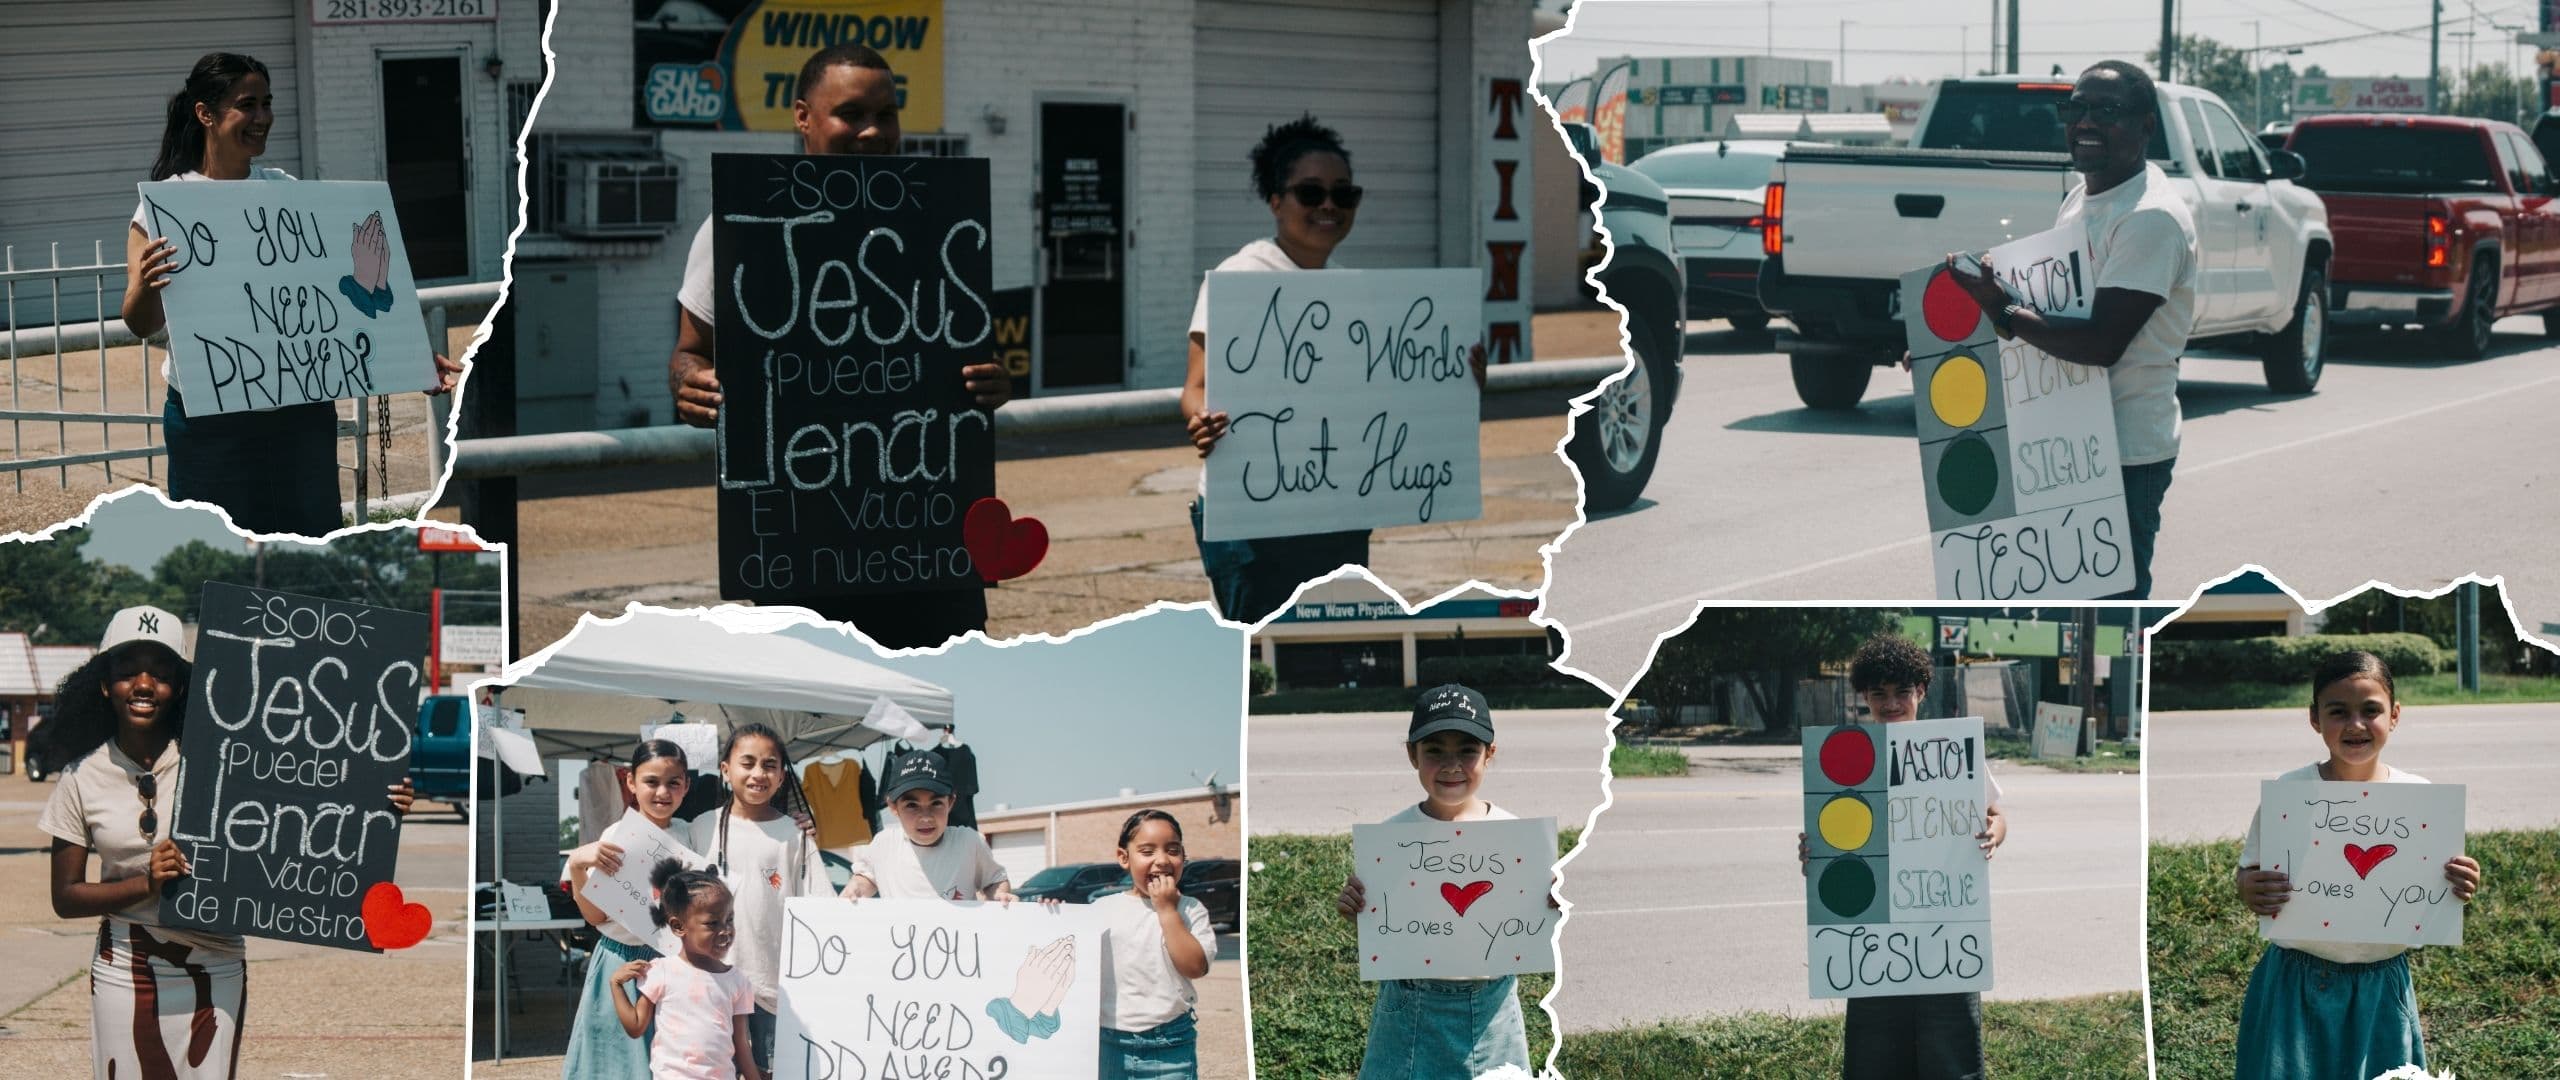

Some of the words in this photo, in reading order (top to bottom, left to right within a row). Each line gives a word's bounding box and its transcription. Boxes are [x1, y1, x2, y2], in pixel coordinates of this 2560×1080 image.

[763, 11, 929, 50] WINDOW
[2372, 81, 2409, 94] OPEN
[2377, 94, 2424, 107] HOURS
[1486, 78, 1526, 363] TINT
[244, 282, 338, 338] NEED
[1226, 287, 1330, 383] No
[1349, 297, 1465, 382] Words
[194, 332, 373, 413] PRAYER?
[1231, 407, 1338, 501] Just
[1358, 411, 1453, 522] Hugs
[2017, 435, 2107, 496] SIGUE
[748, 490, 797, 537] El
[739, 536, 793, 590] de
[812, 539, 972, 585] nuestro
[138, 611, 160, 634] NY
[1296, 604, 1321, 618] New
[1326, 604, 1354, 617] Wave
[1358, 602, 1407, 619] Physicia
[1888, 796, 1986, 841] PIENSA
[2305, 800, 2410, 839] Jesus
[191, 841, 228, 883] El
[1398, 840, 1505, 875] Jesus
[176, 880, 219, 924] de
[233, 897, 366, 941] nuestro
[512, 898, 544, 914] Free
[1893, 869, 1979, 910] SIGUE
[1378, 892, 1454, 935] Loves
[1815, 925, 1984, 991] JESÚS
[866, 994, 973, 1050] NEED
